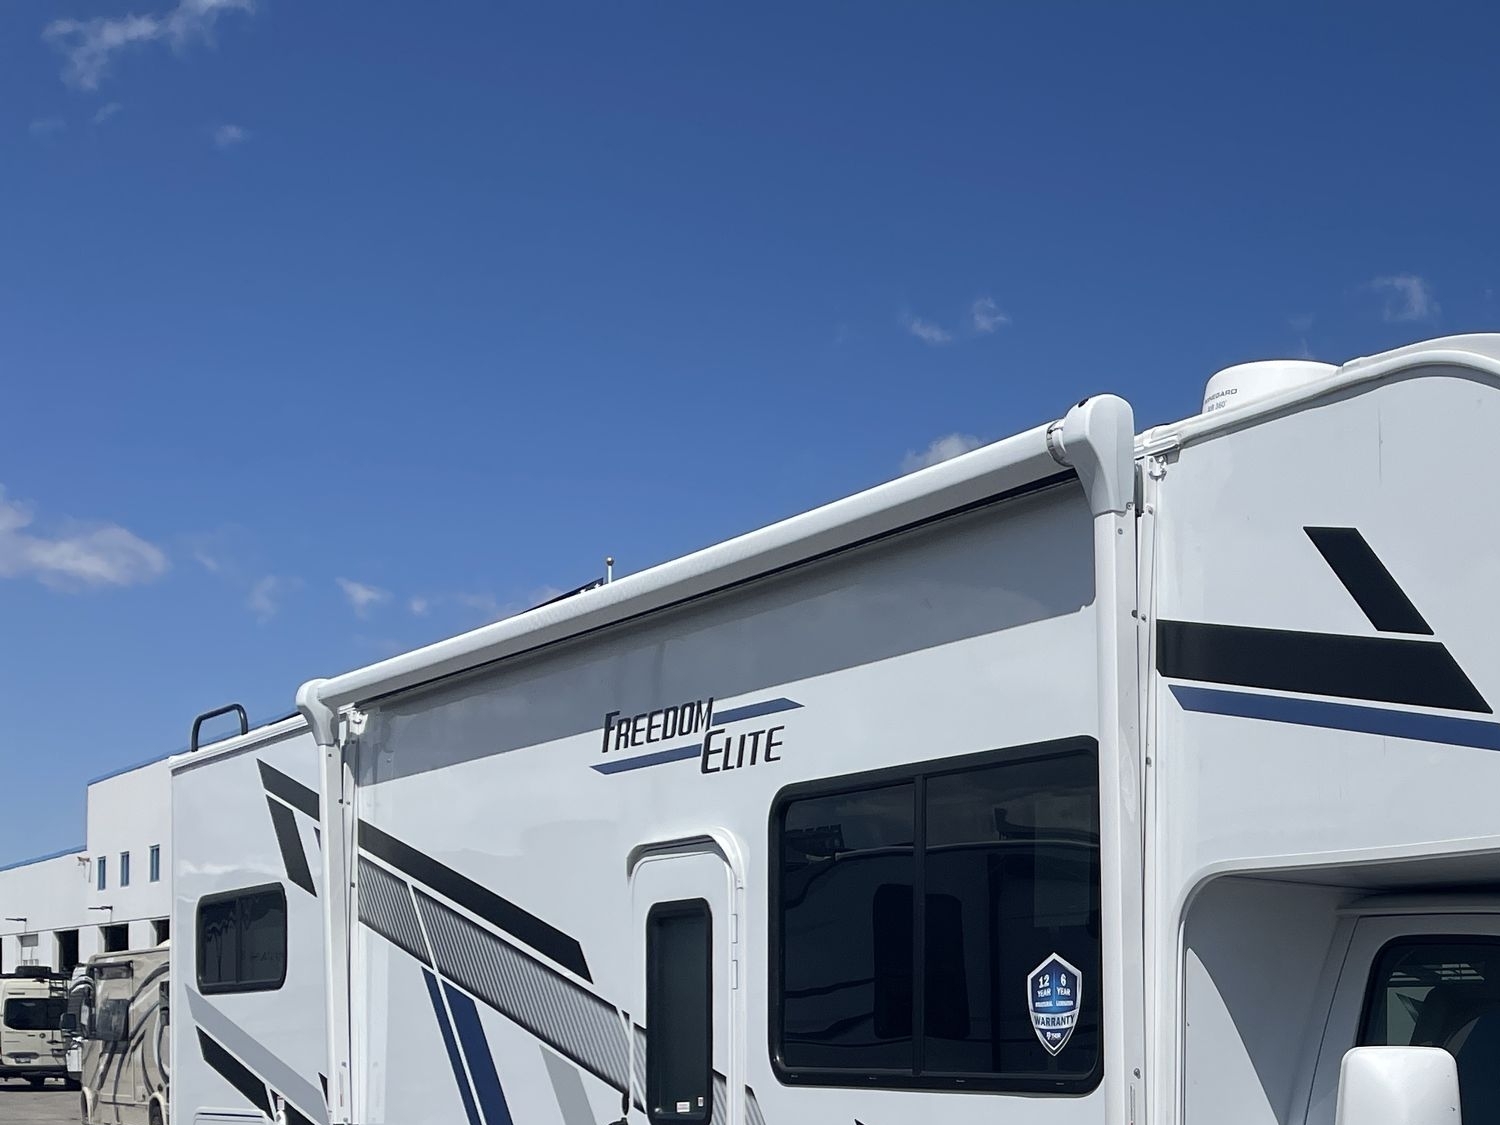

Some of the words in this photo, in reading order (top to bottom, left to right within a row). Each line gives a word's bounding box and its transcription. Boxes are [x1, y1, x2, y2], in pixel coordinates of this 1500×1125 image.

[601, 697, 714, 753] FREEDOM
[701, 726, 785, 774] ELITE
[1038, 974, 1050, 988] 12
[1060, 973, 1067, 987] 6
[1037, 988, 1052, 998] YEAR
[1056, 987, 1071, 996] YEAR
[1034, 1015, 1075, 1027] WARRANTY
